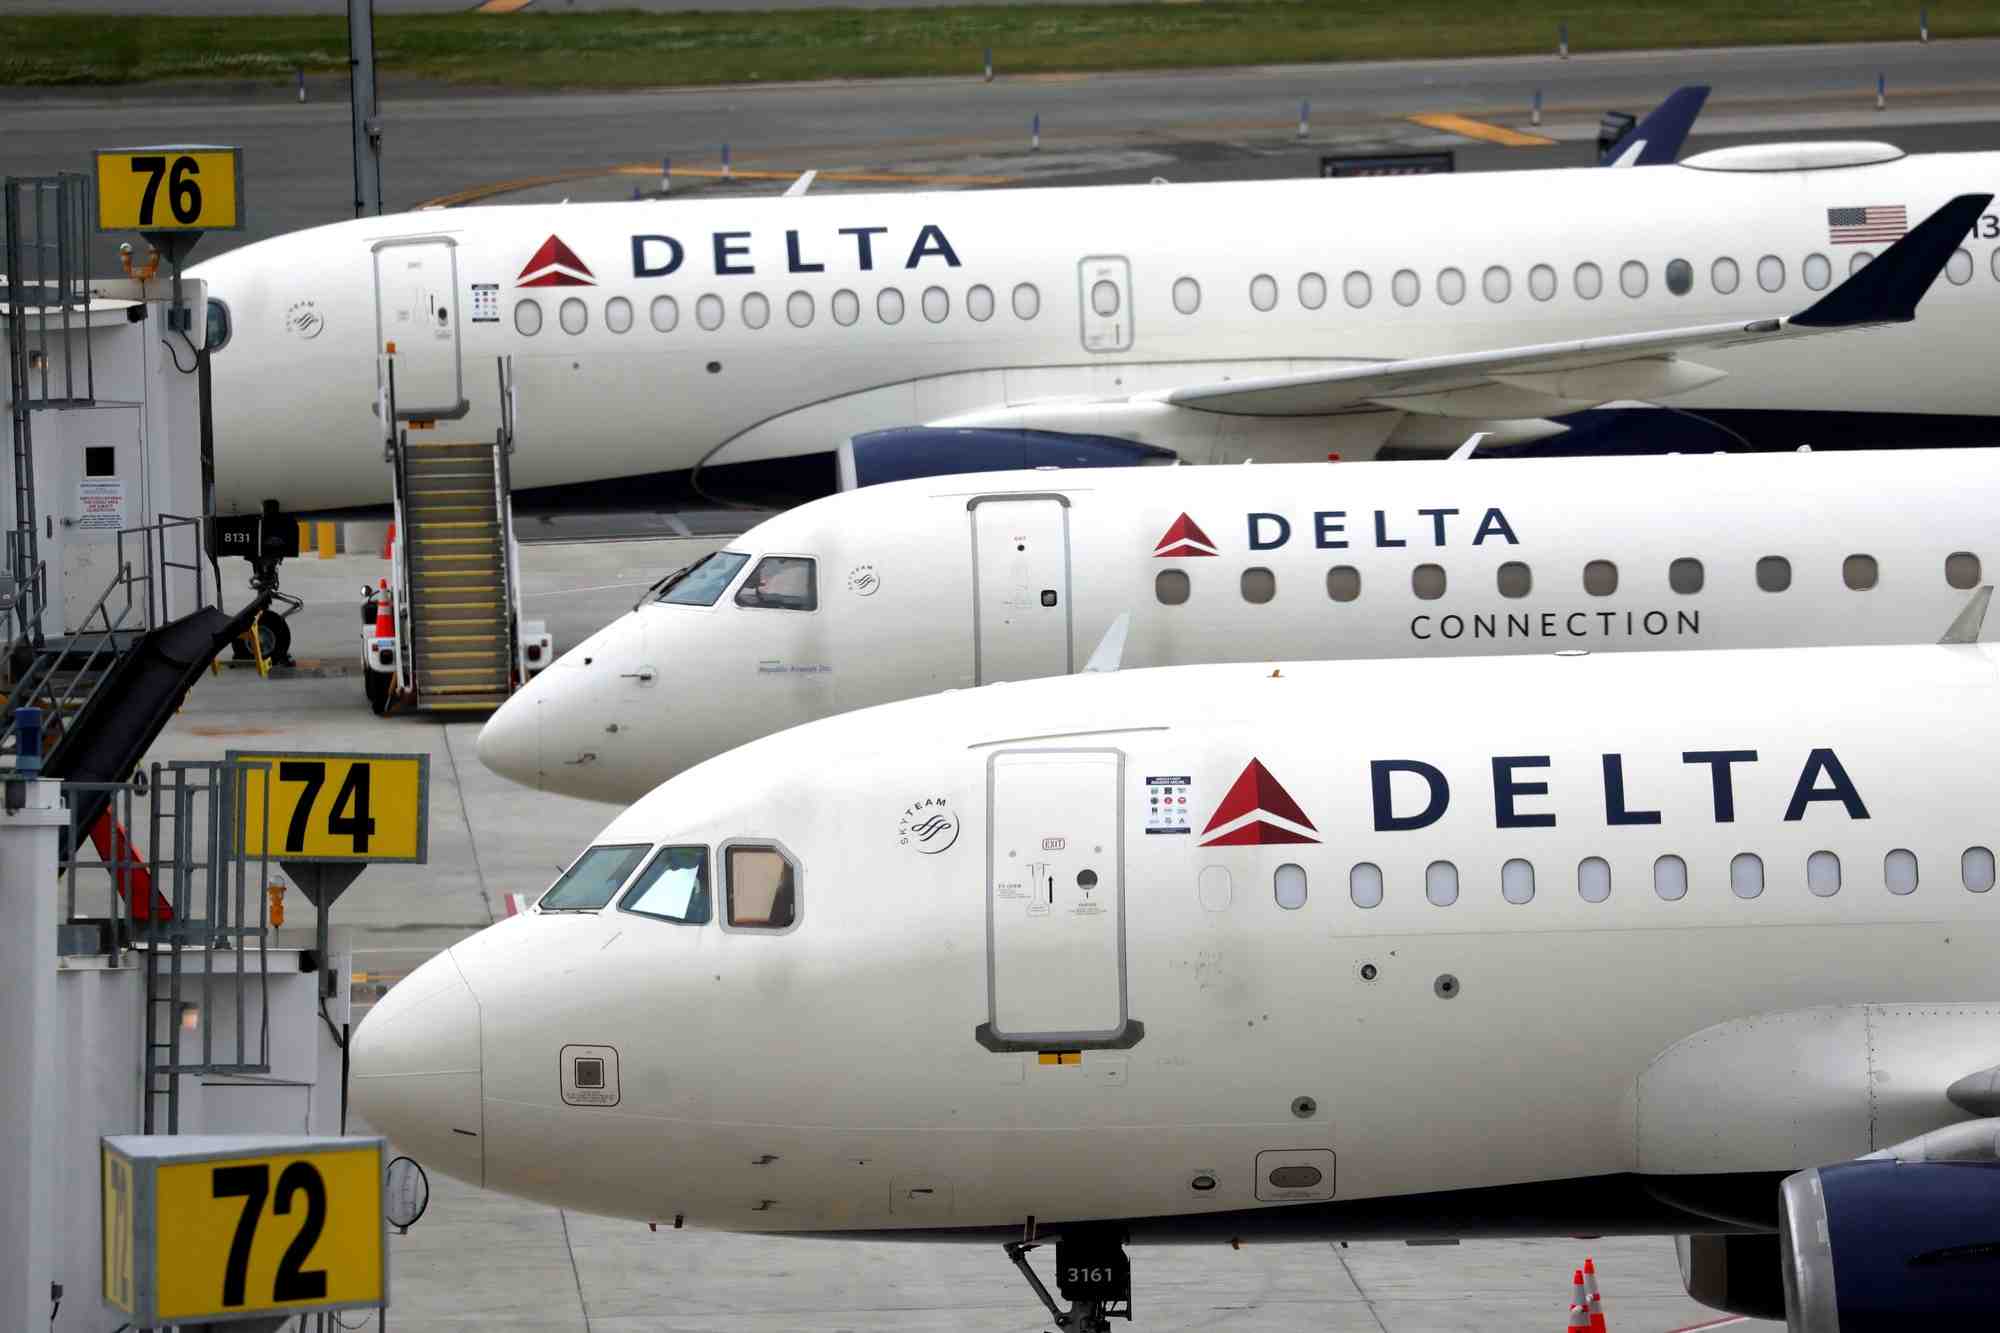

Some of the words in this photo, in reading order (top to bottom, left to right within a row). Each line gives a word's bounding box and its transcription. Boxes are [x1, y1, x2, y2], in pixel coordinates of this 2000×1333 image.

[131, 155, 202, 227] 76
[632, 225, 962, 279] DELTA
[224, 533, 250, 543] 8131
[1247, 508, 1520, 551] DELTA
[1411, 610, 1700, 640] CONNECTION
[279, 762, 376, 854] 74
[1371, 748, 1871, 832] DELTA
[899, 797, 947, 846] SKYTEAM
[212, 1161, 327, 1307] 72
[1068, 1267, 1112, 1282] 3161
